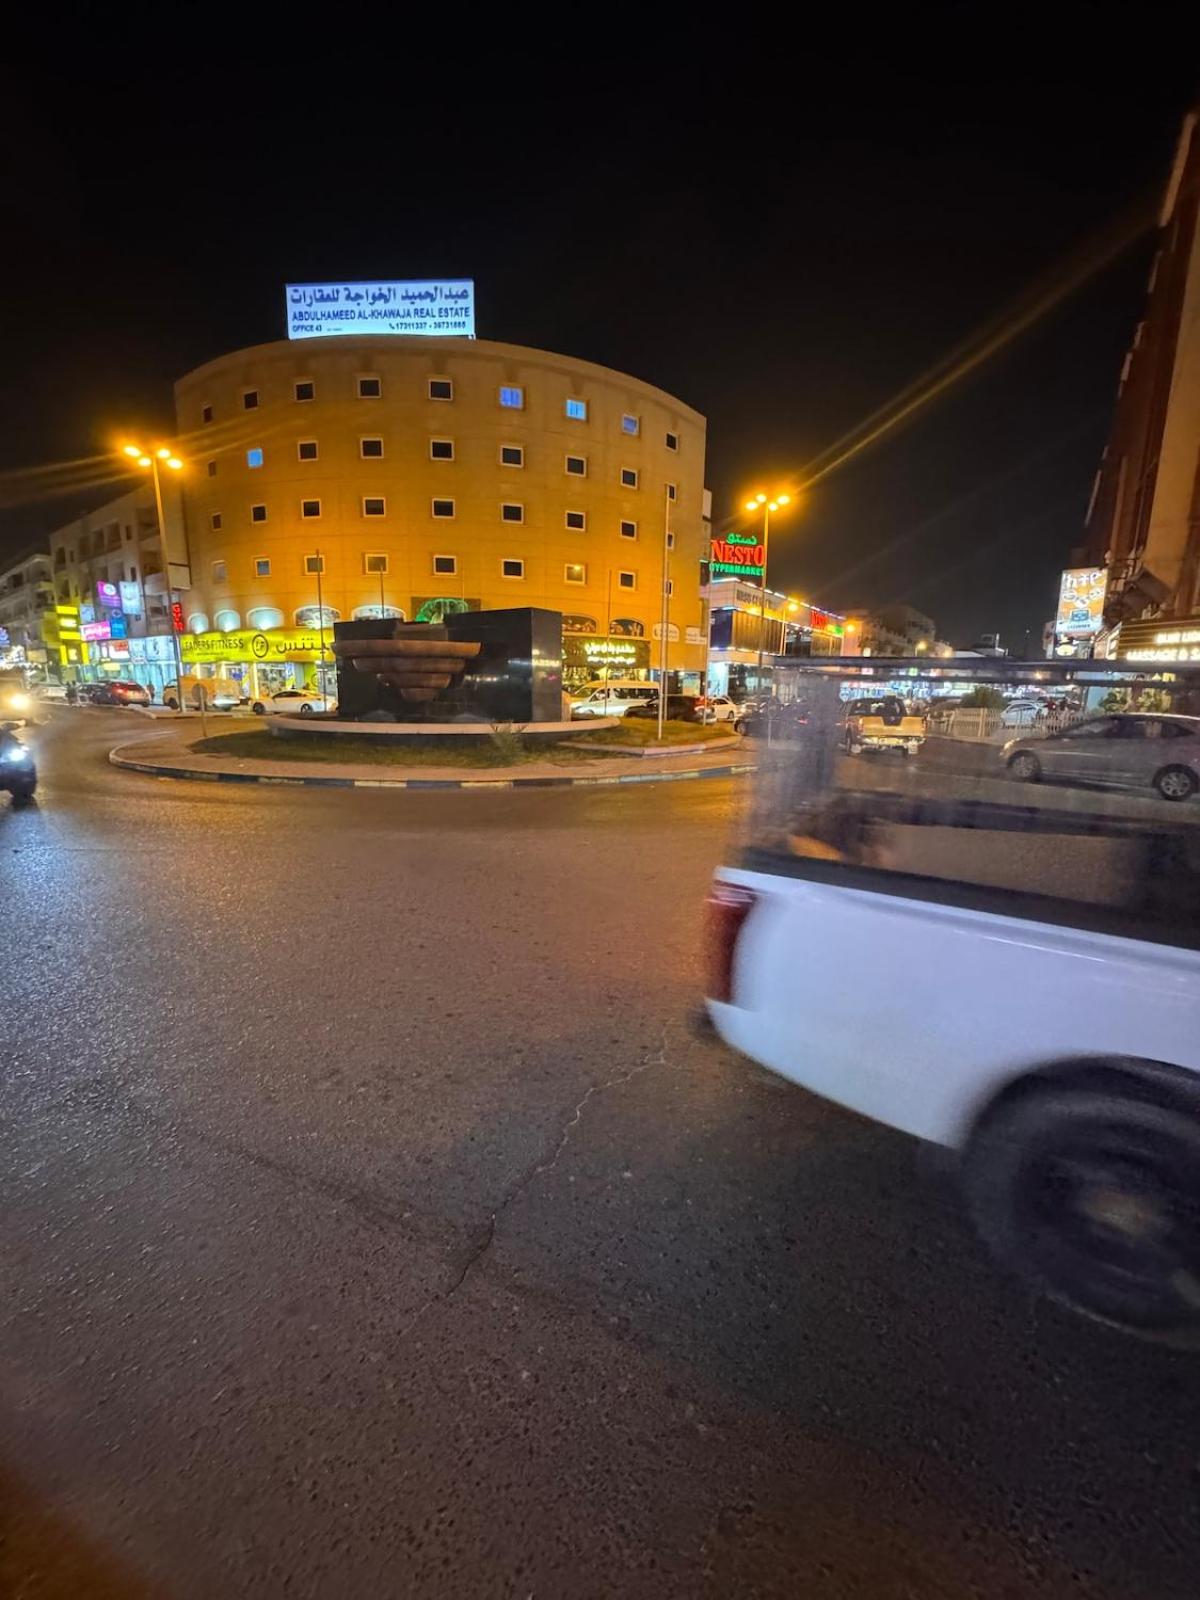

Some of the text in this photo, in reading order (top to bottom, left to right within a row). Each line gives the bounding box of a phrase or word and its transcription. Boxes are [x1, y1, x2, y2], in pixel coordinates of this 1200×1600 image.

[290, 288, 340, 307] للعقارات
[343, 287, 396, 306] الخواجة
[292, 306, 470, 321] ABDULHAMEED AL-KHAWAJA REAL ESTATE
[292, 324, 315, 332] OFFICE
[710, 539, 764, 566] NESTO
[709, 562, 764, 576] HYPERMARKET
[212, 638, 245, 650] FITNESS
